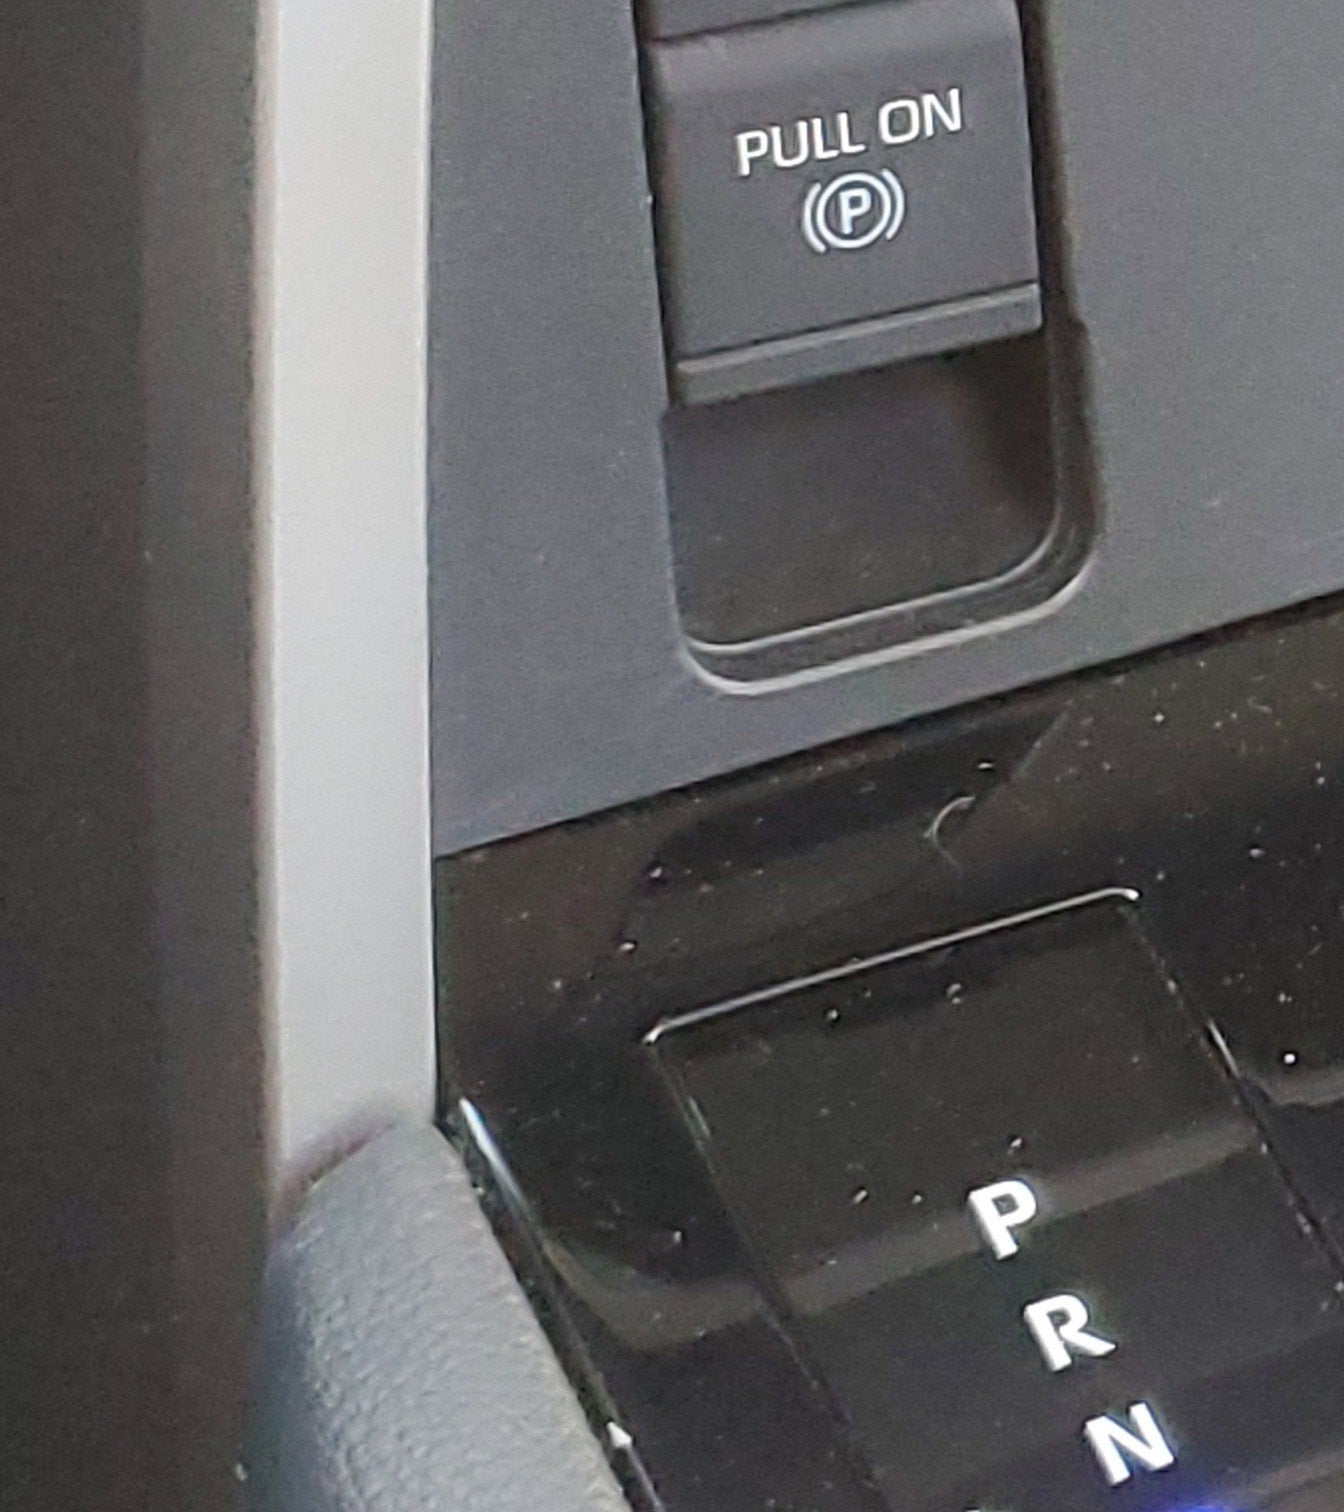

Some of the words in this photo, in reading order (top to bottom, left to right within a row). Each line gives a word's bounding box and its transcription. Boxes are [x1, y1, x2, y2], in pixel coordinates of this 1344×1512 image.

[736, 112, 866, 176] PULL
[878, 88, 963, 144] ON
[838, 190, 871, 234] P
[967, 1179, 1037, 1260] P
[1023, 1293, 1116, 1372] R
[1083, 1401, 1175, 1486] N
